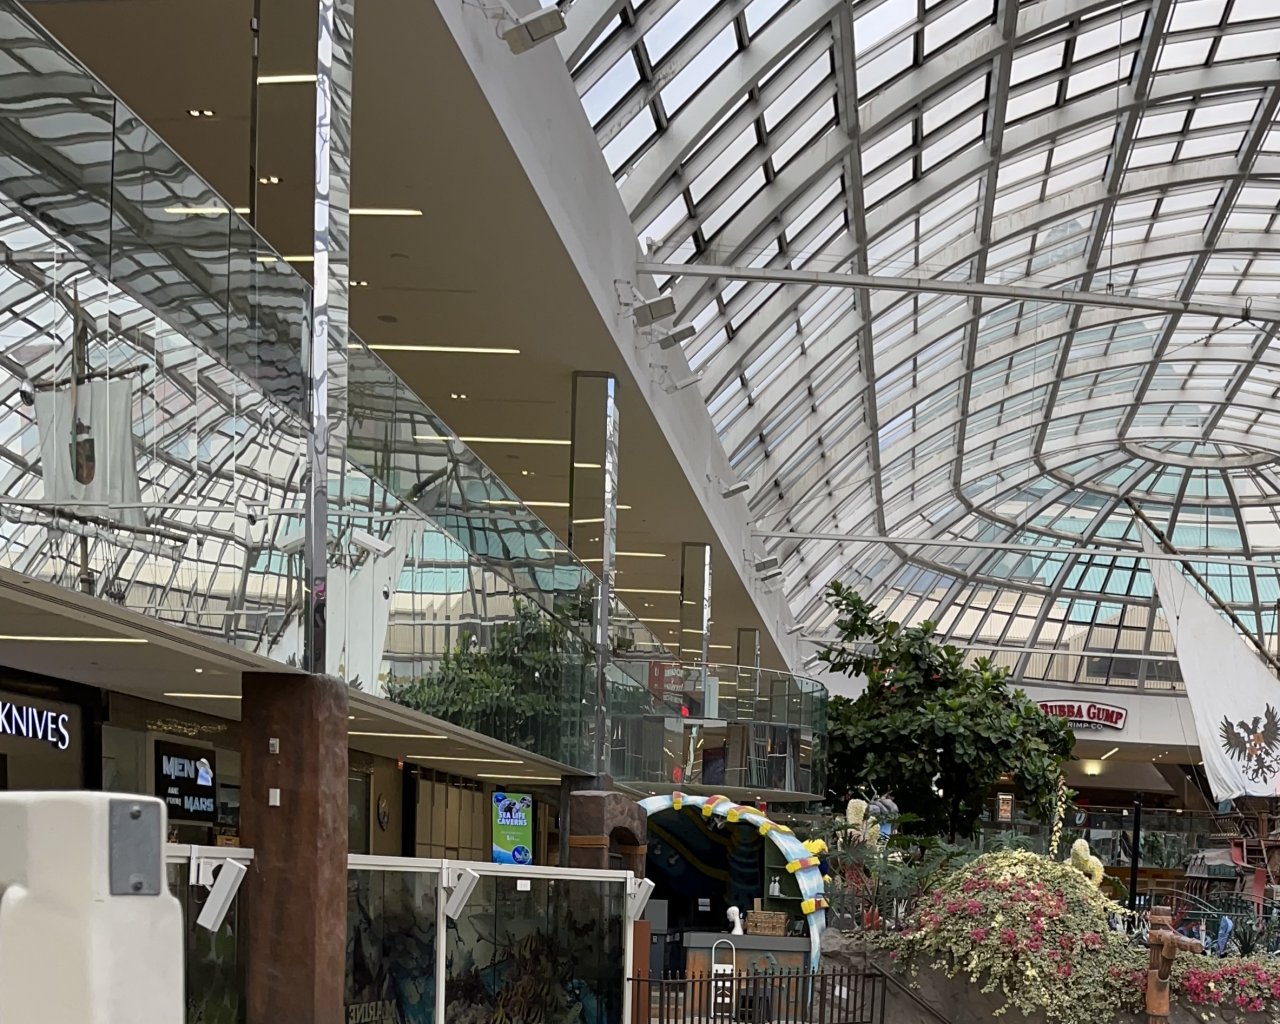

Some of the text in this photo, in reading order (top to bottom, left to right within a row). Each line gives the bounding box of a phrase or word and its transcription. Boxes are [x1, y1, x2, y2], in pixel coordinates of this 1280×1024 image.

[0, 700, 70, 750] KNIVES
[1039, 703, 1124, 725] BUBBA GUMP
[163, 755, 195, 780] MEN
[184, 796, 214, 813] MARS
[497, 818, 527, 826] CAVERNS
